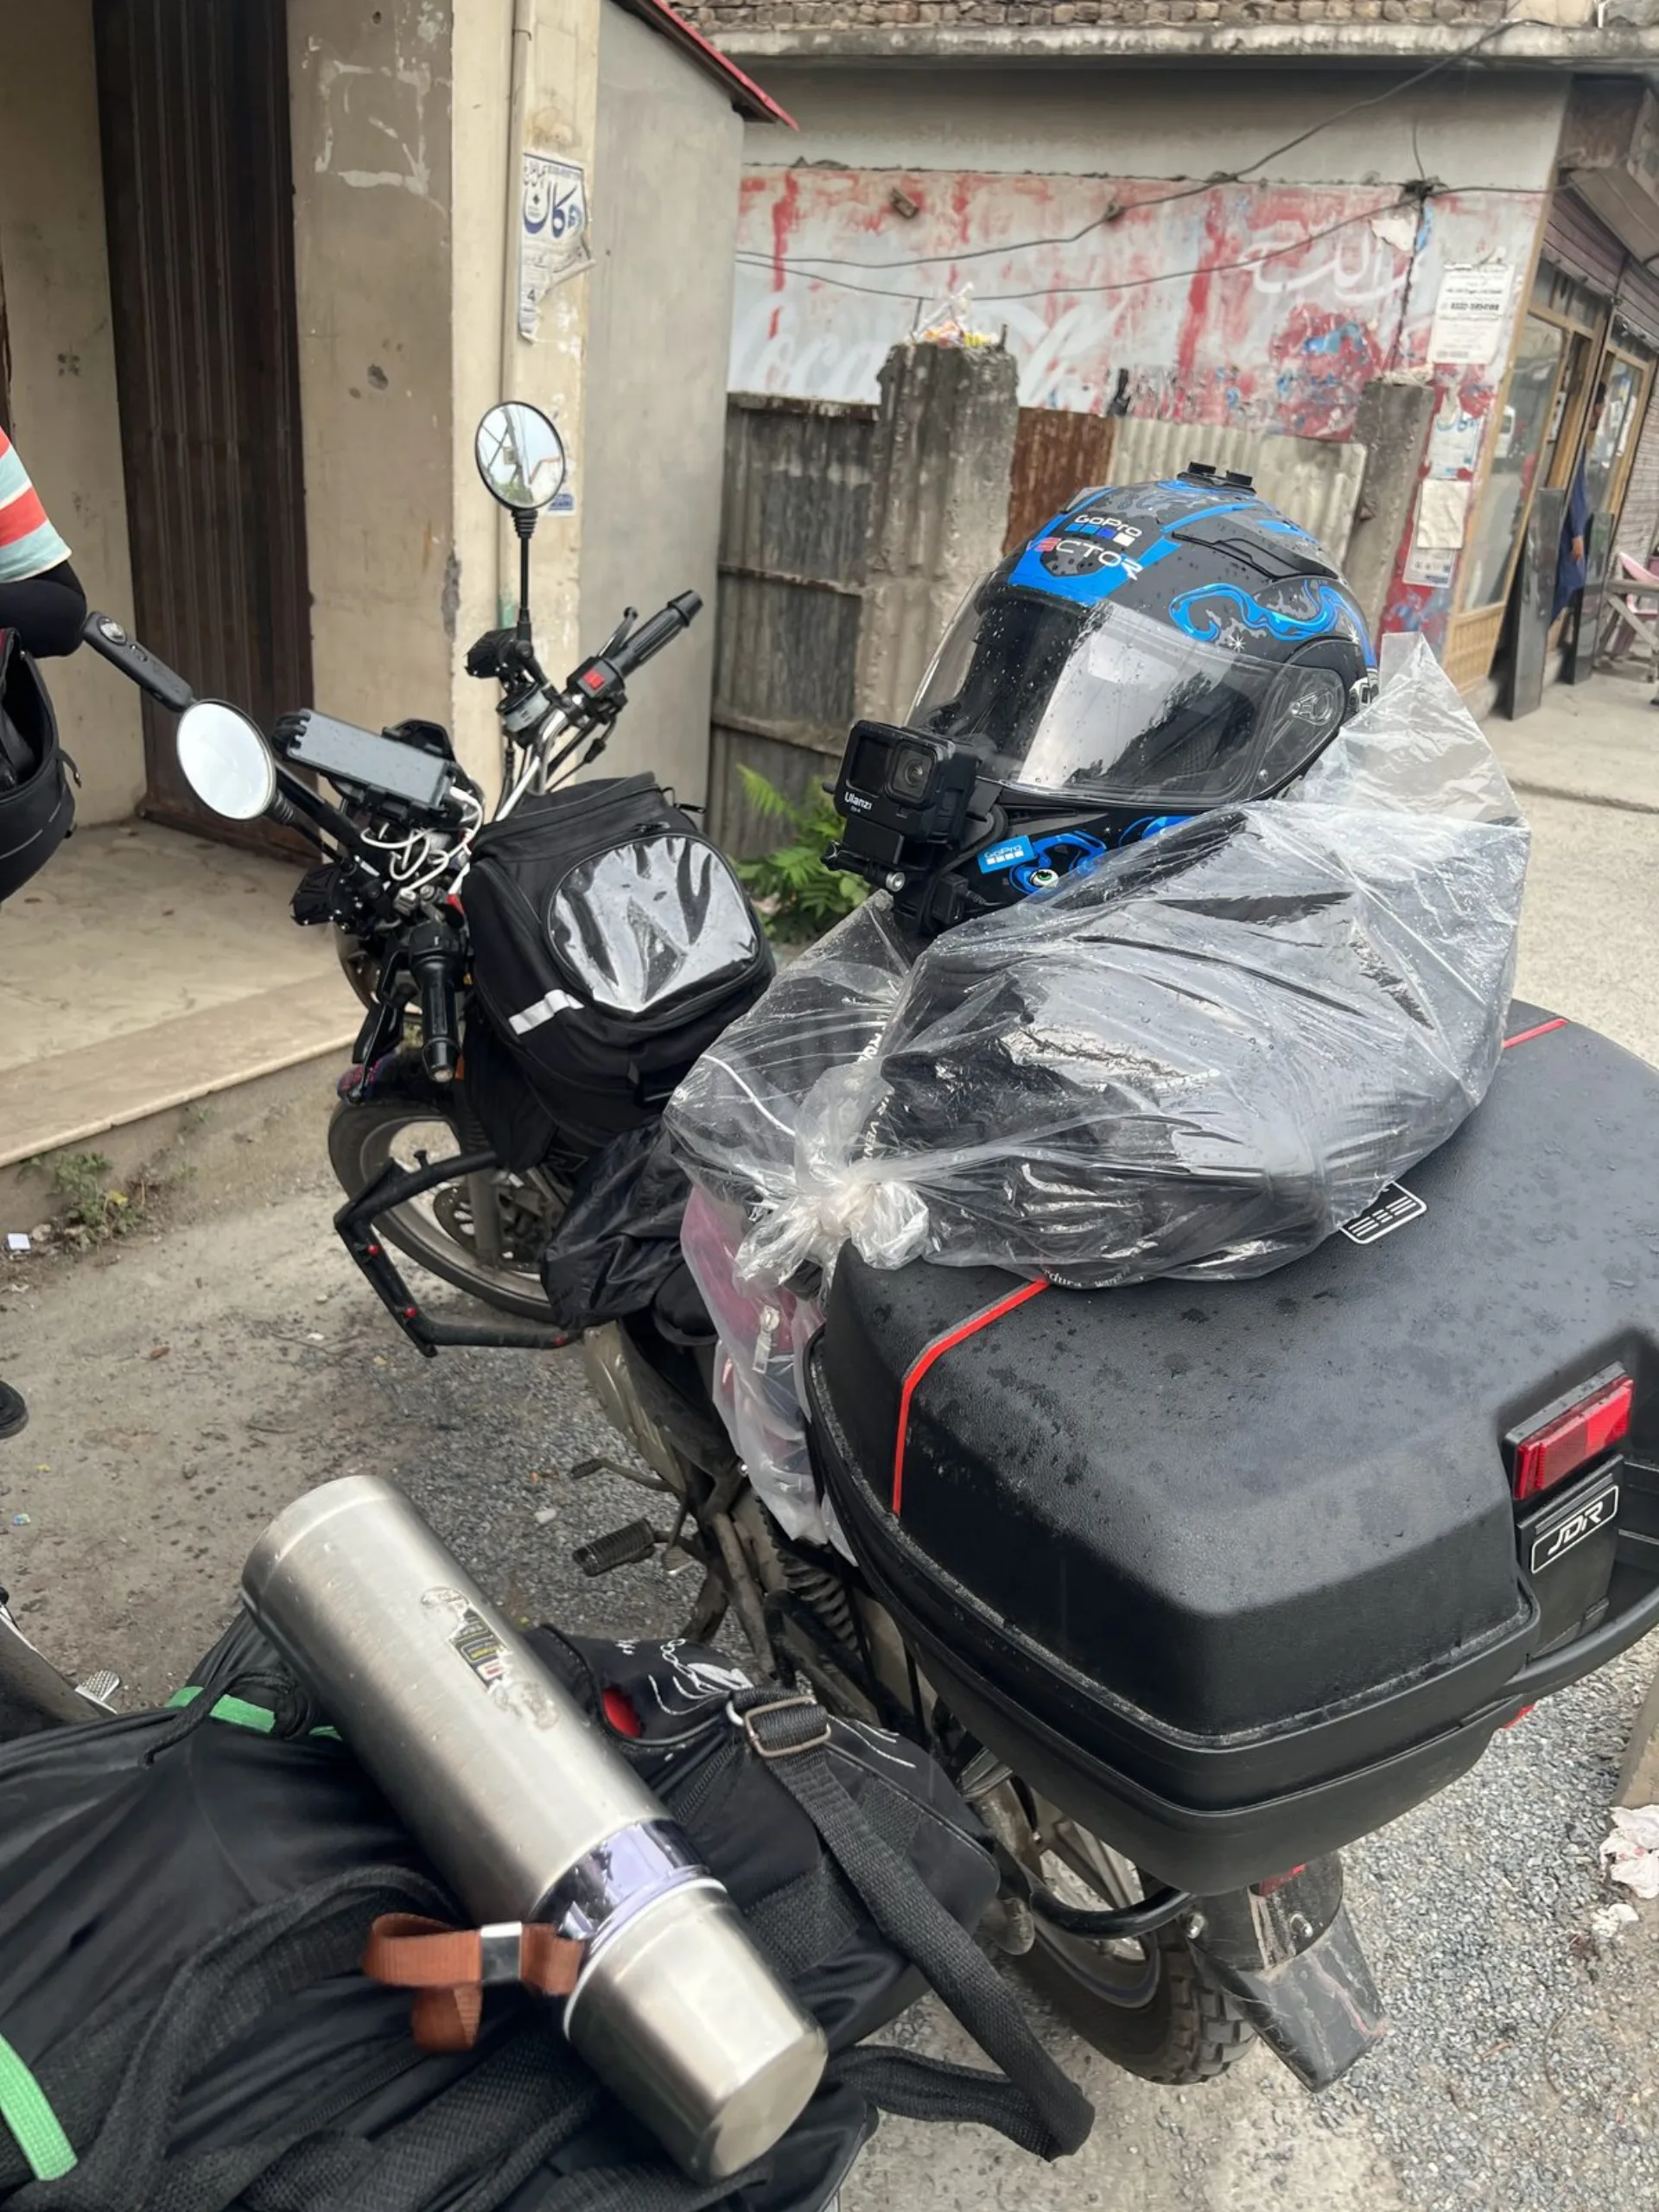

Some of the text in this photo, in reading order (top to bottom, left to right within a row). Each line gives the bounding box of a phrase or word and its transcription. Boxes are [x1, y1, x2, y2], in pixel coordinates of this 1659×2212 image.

[1074, 514, 1142, 537] GoPro
[844, 791, 873, 811] Ulanzi
[983, 844, 1023, 859] GoPro
[1547, 1500, 1605, 1556] JDR
